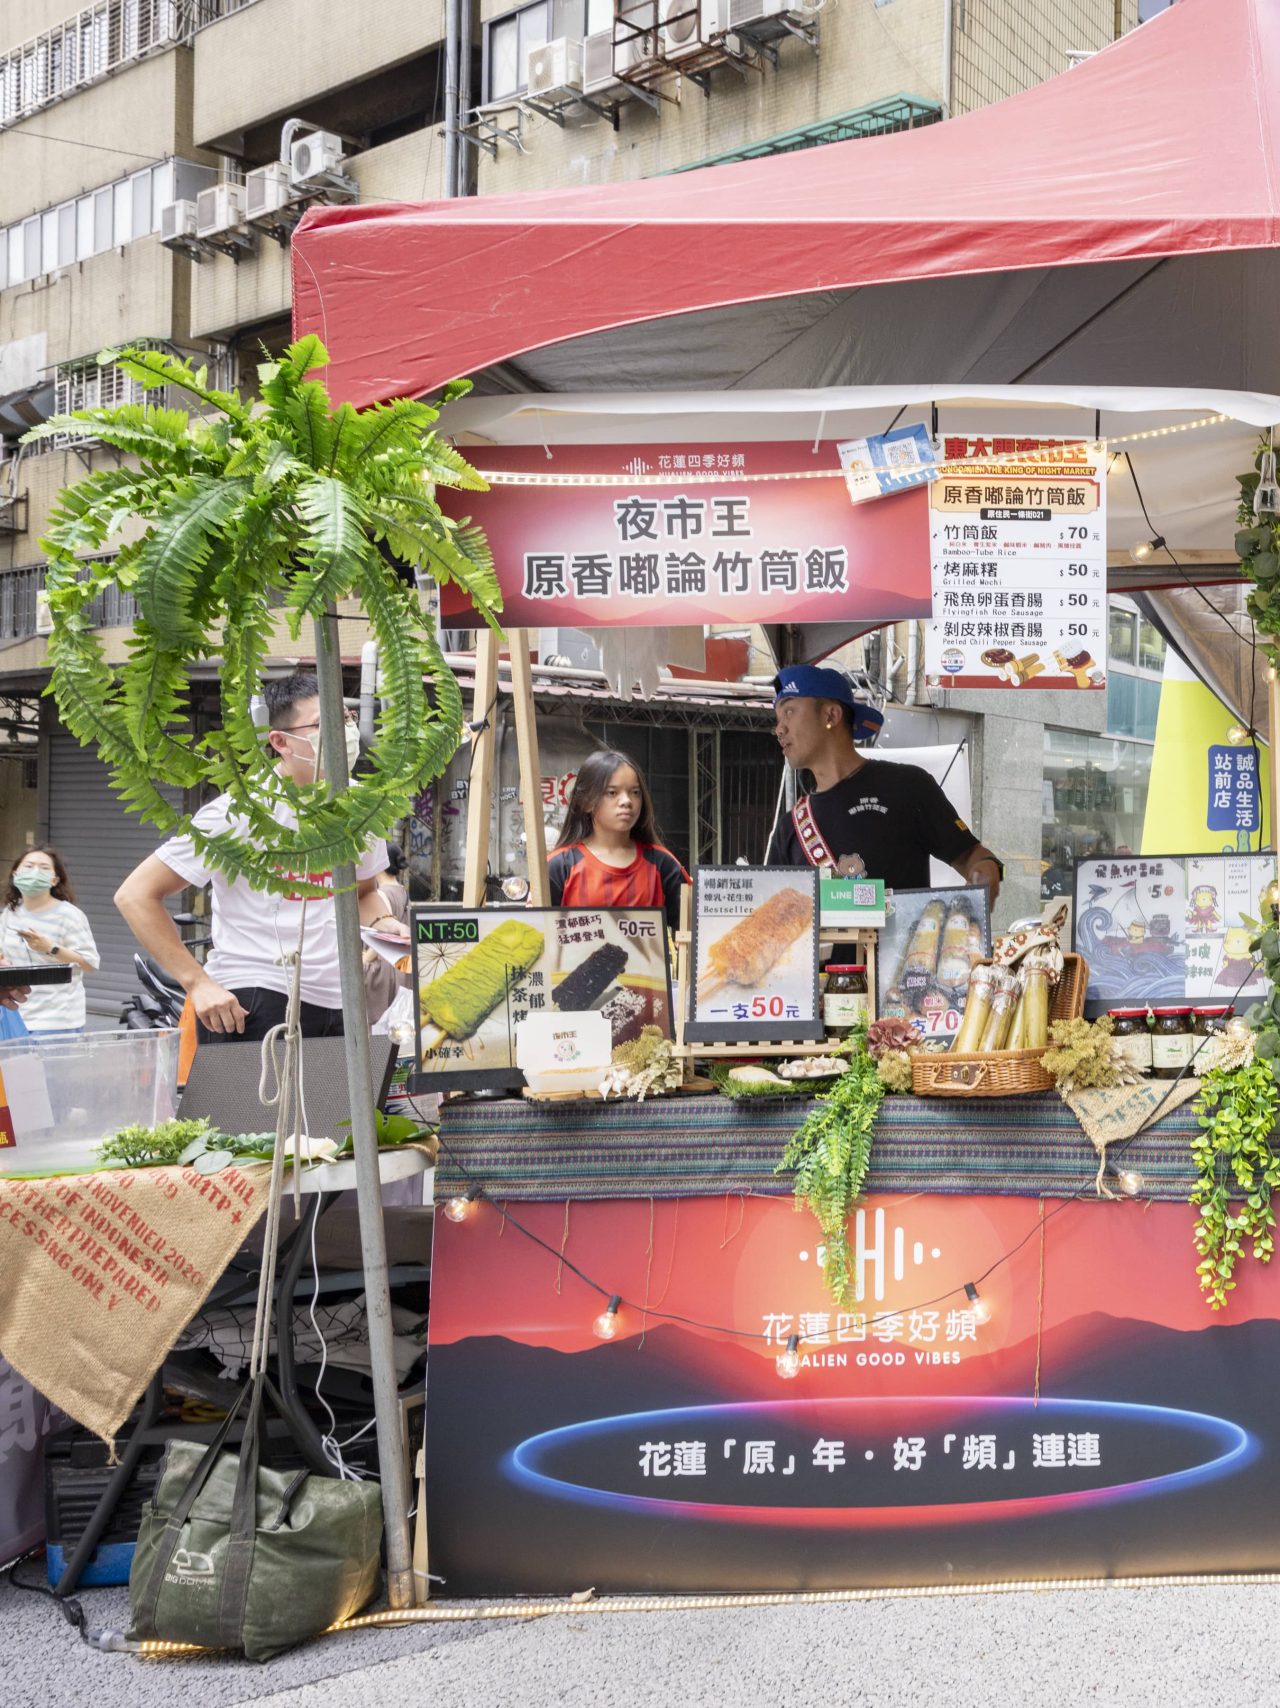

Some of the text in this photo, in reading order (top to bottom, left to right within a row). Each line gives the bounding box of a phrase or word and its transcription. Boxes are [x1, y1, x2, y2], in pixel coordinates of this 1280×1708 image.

[658, 453, 746, 469] 花蓮四季好頻
[1004, 466, 1024, 475] KING
[1037, 466, 1062, 475] NIGHT
[1063, 466, 1096, 476] MARKET
[943, 485, 1086, 506] 原香嘟論竹筒飯
[614, 497, 752, 542] 夜市王
[943, 525, 998, 540] 竹筒飯
[1068, 526, 1088, 539] 70
[943, 548, 994, 556] Bamboo-Tube
[523, 547, 848, 599] 原香嘟論竹筒飯
[1068, 564, 1088, 576] 50
[943, 578, 1002, 586] Grilled Mochi
[1068, 594, 1088, 606] 50
[943, 608, 989, 617] Flyingfish
[1011, 609, 1044, 617] Sausage
[1068, 623, 1088, 636] 50
[970, 638, 989, 646] Chili
[993, 639, 1016, 647] Pepper
[1020, 639, 1048, 647] Sausage
[1213, 753, 1233, 808] 站前店
[1236, 753, 1255, 827] 誠品生活
[831, 890, 853, 900] LINE
[703, 905, 753, 914] Bestseller
[418, 922, 478, 940] NT:50
[618, 920, 657, 937] 50元
[510, 965, 528, 1025] 抹茶烤
[528, 971, 546, 1009] 濃郁
[425, 1046, 465, 1059] 小確幸
[80, 1202, 170, 1288] INDONESIA
[0, 1200, 123, 1312] CESSING ONLY
[66, 1226, 162, 1313] PREPARED
[762, 1311, 978, 1346] 花蓮四季好頻
[856, 1352, 906, 1367] GOOD
[914, 1350, 961, 1365] VIBES
